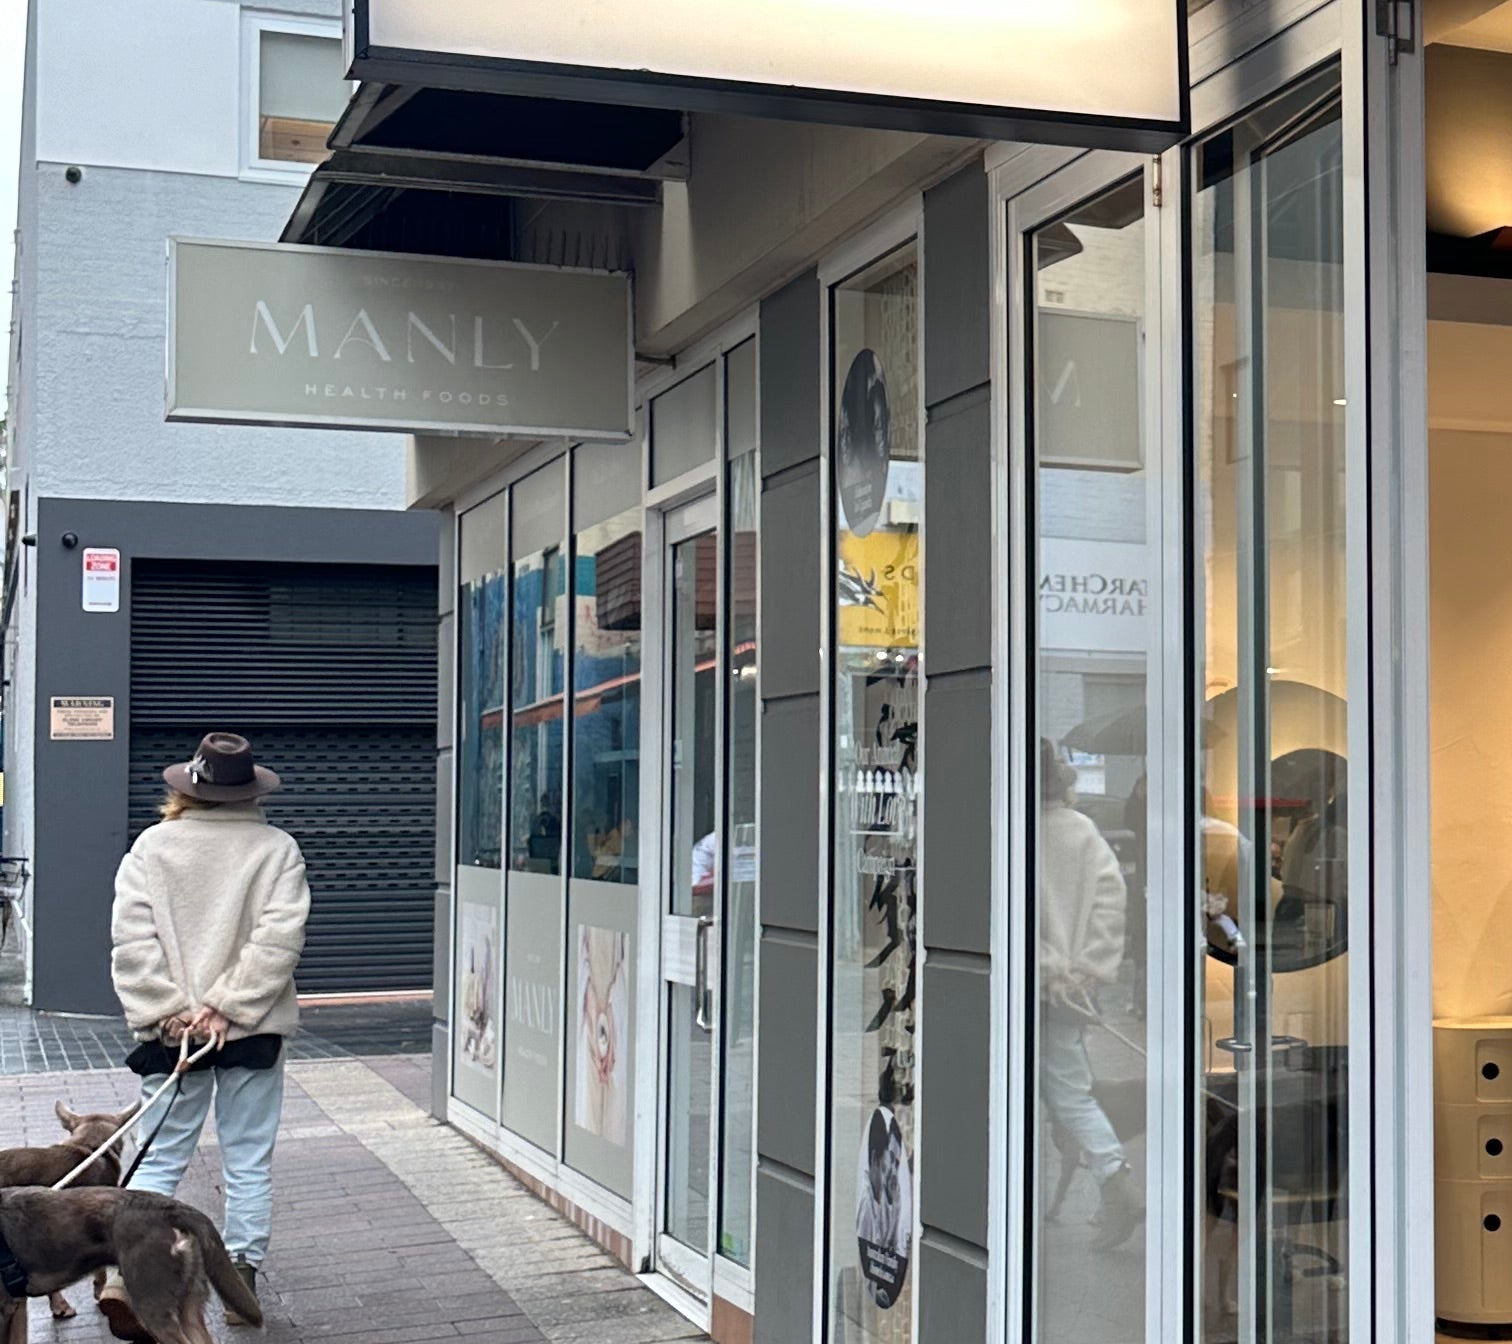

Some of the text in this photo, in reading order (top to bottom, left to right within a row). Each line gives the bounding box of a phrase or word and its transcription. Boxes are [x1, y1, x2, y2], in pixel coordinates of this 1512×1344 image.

[249, 299, 560, 371] MANLY
[304, 383, 510, 406] HEALTH FOODS
